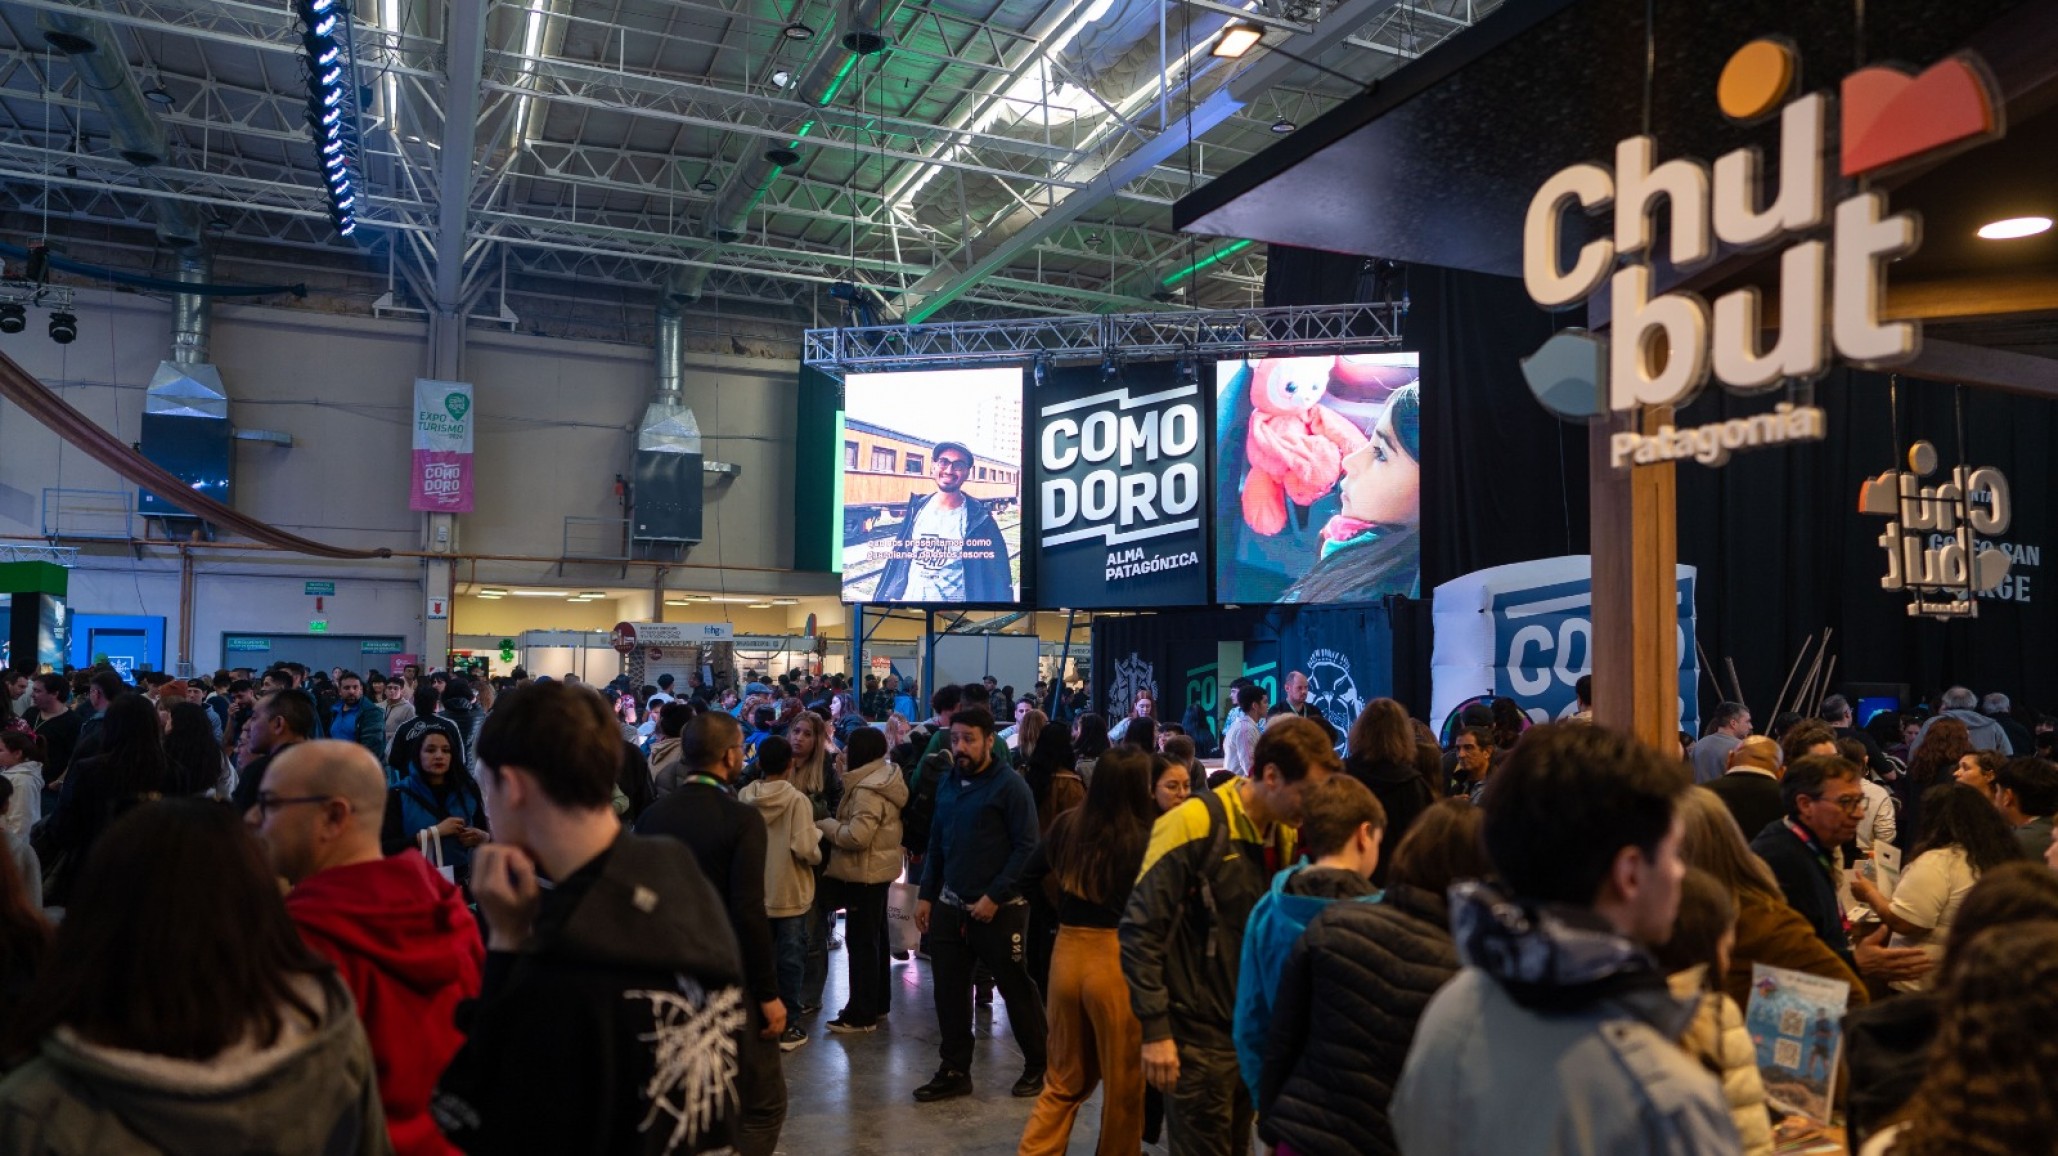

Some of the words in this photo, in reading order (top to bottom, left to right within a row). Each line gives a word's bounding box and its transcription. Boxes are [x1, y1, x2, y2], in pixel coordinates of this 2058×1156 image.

[1610, 192, 1914, 412] but
[418, 421, 464, 434] TURISMO
[420, 411, 447, 423] EXPO
[1041, 403, 1198, 471] COMO
[1610, 404, 1825, 468] Patagonia
[424, 479, 460, 492] DORO
[425, 466, 460, 480] COMO
[1041, 462, 1198, 531] DORO
[1105, 551, 1199, 582] PATAGÓNICA
[1106, 547, 1145, 566] ALMA
[2000, 542, 2040, 566] SAN
[1187, 674, 1277, 711] COO
